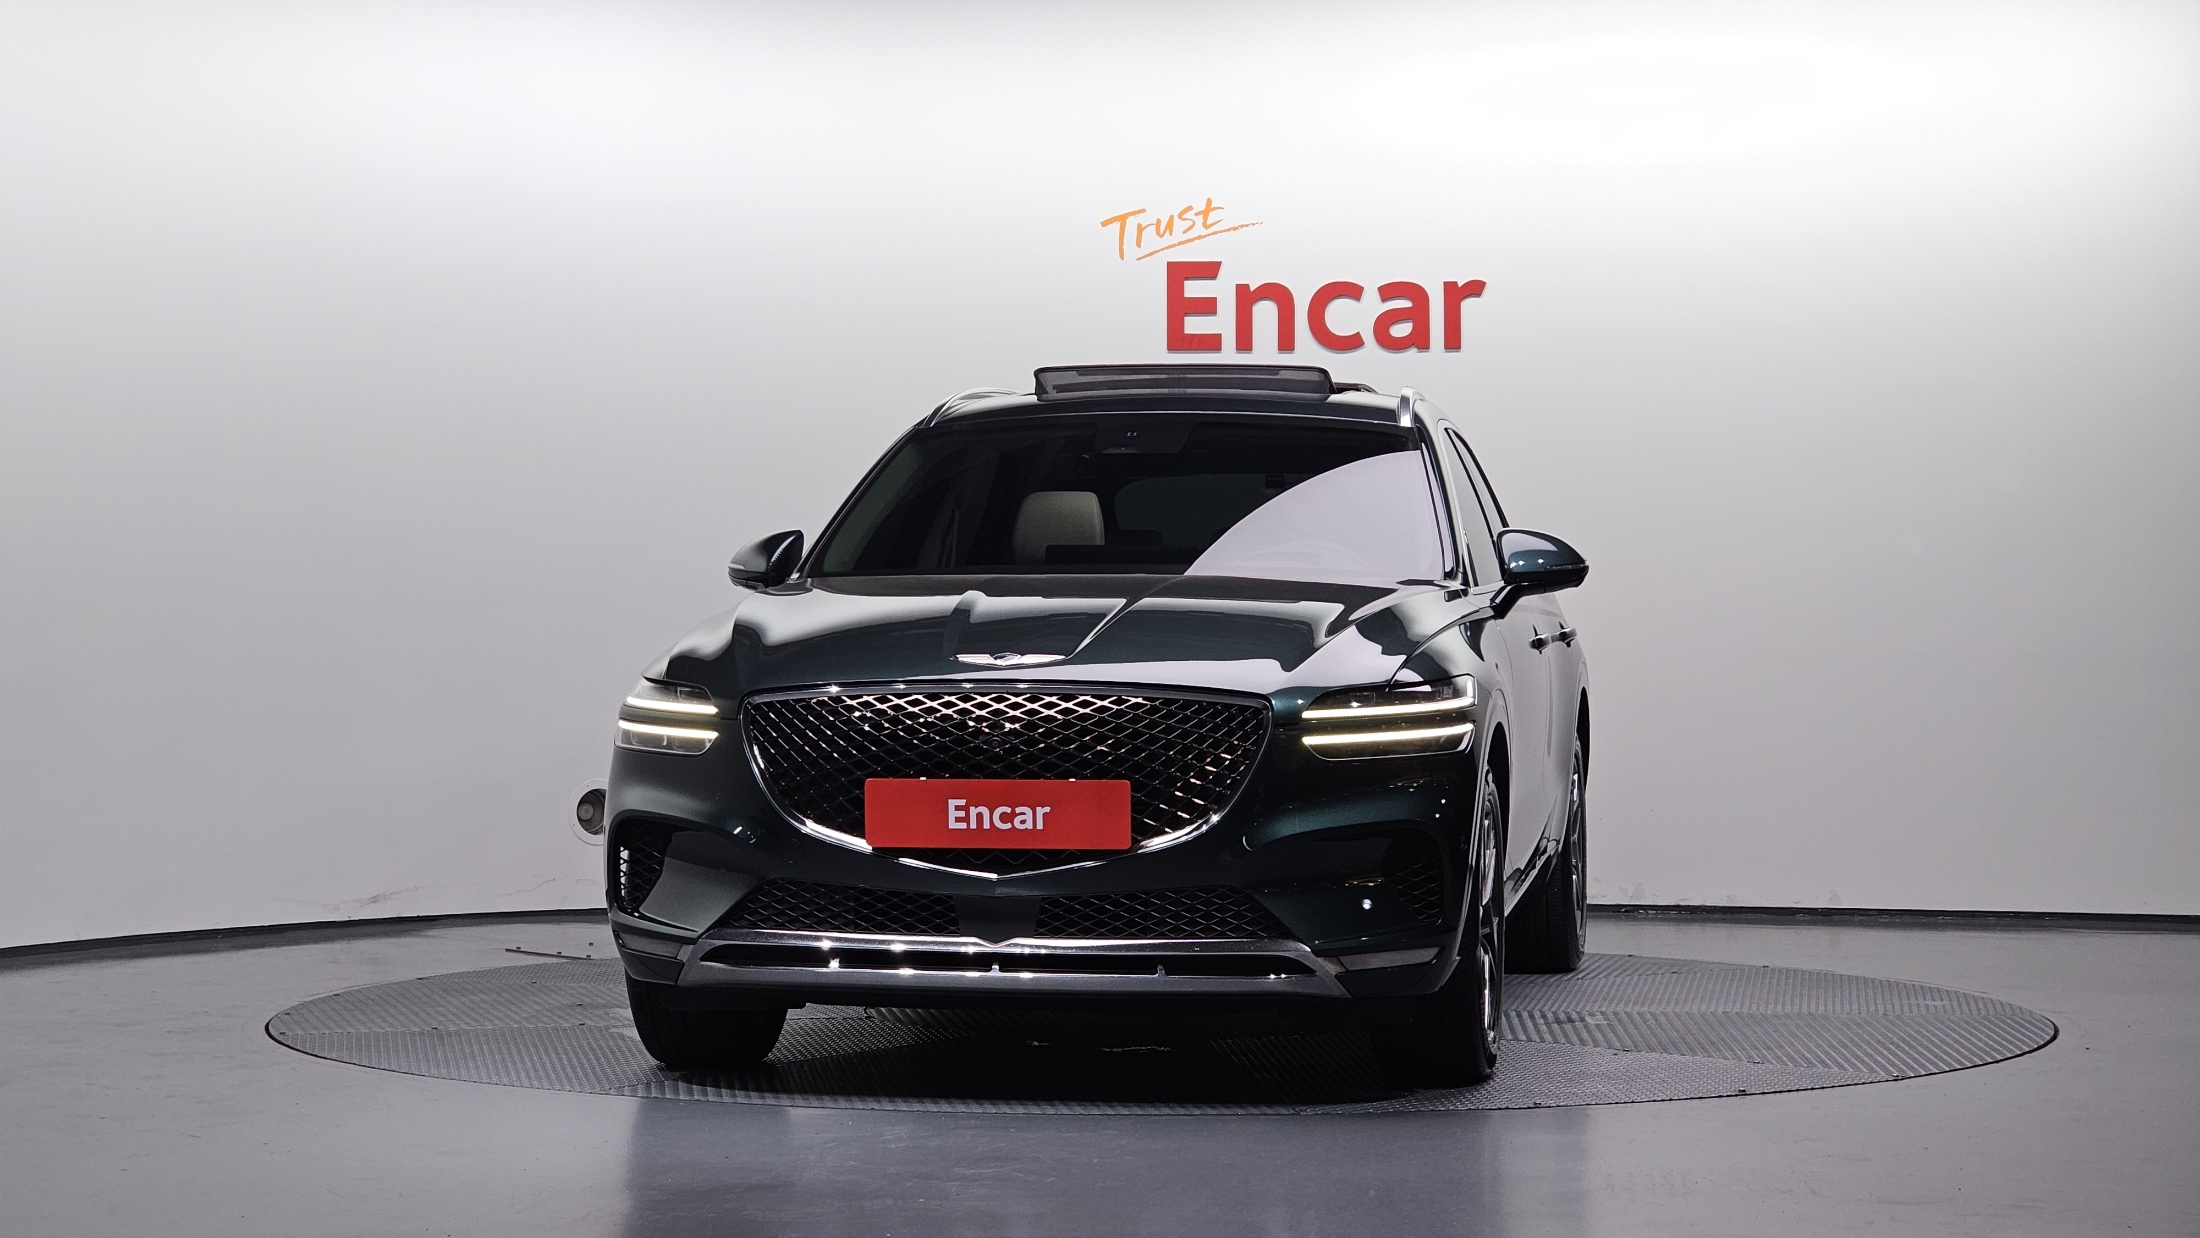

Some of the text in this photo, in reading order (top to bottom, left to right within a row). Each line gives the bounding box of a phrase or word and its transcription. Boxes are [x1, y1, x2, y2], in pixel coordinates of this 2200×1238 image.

[1101, 197, 1225, 260] Trust
[1166, 260, 1487, 352] Encar
[946, 798, 1052, 831] Encar
